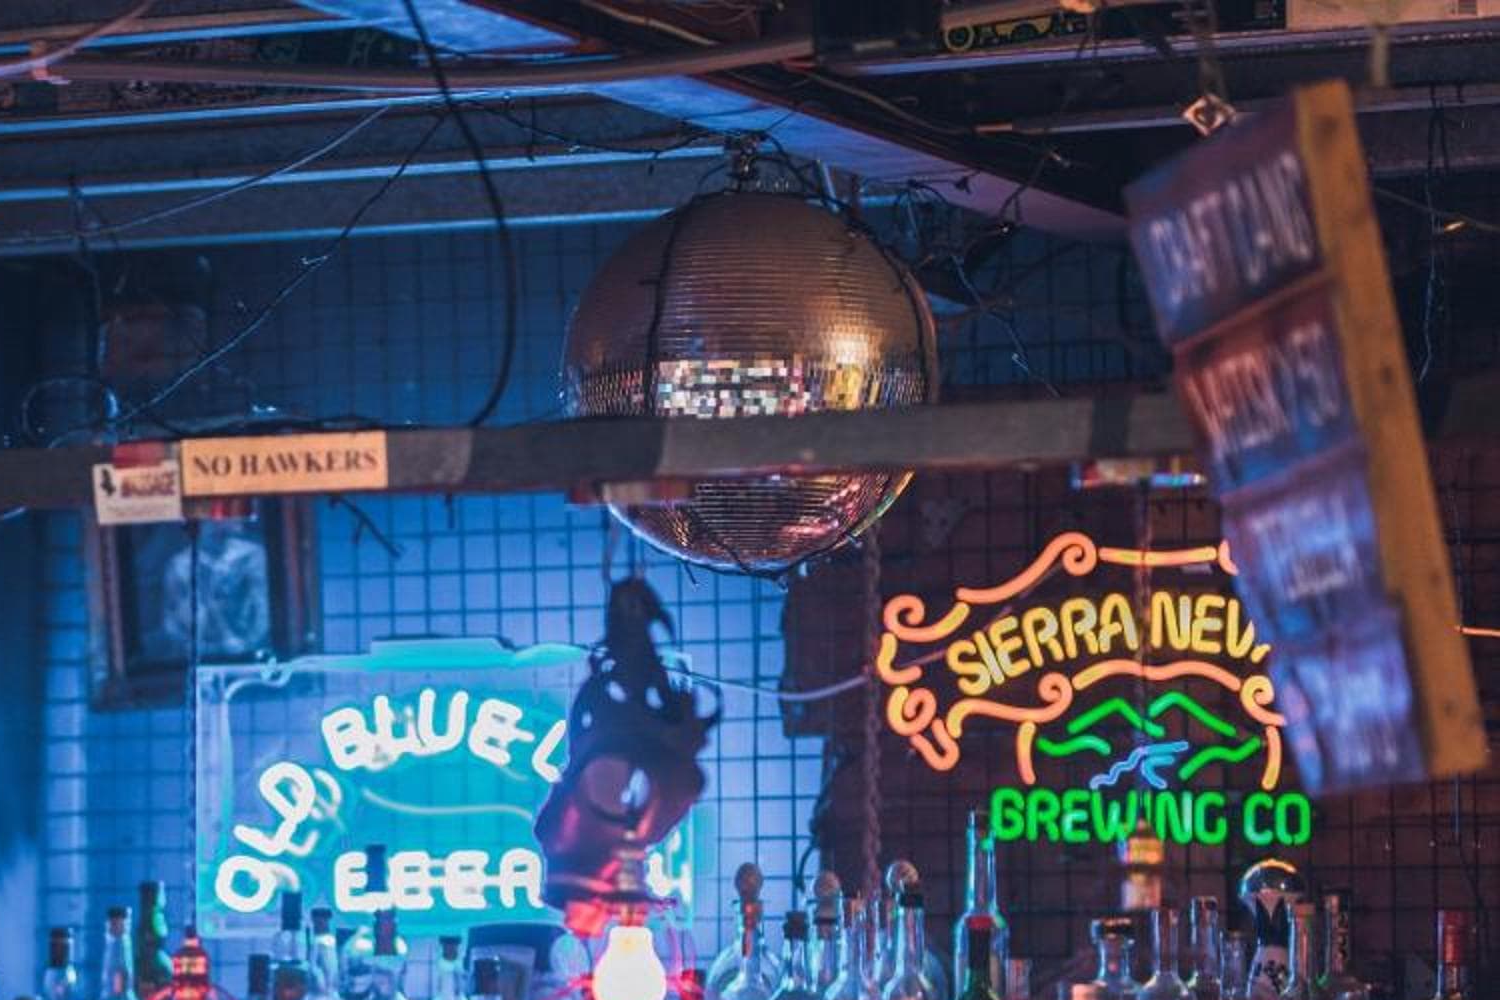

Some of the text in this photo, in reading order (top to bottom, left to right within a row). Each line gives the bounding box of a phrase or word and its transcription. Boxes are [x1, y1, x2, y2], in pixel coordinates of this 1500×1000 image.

[193, 449, 379, 477] NO HAWKERS
[946, 592, 1139, 697] SIERRA
[215, 760, 316, 913] OLD
[321, 688, 536, 771] BLUE
[990, 786, 1312, 847] BREWING CO
